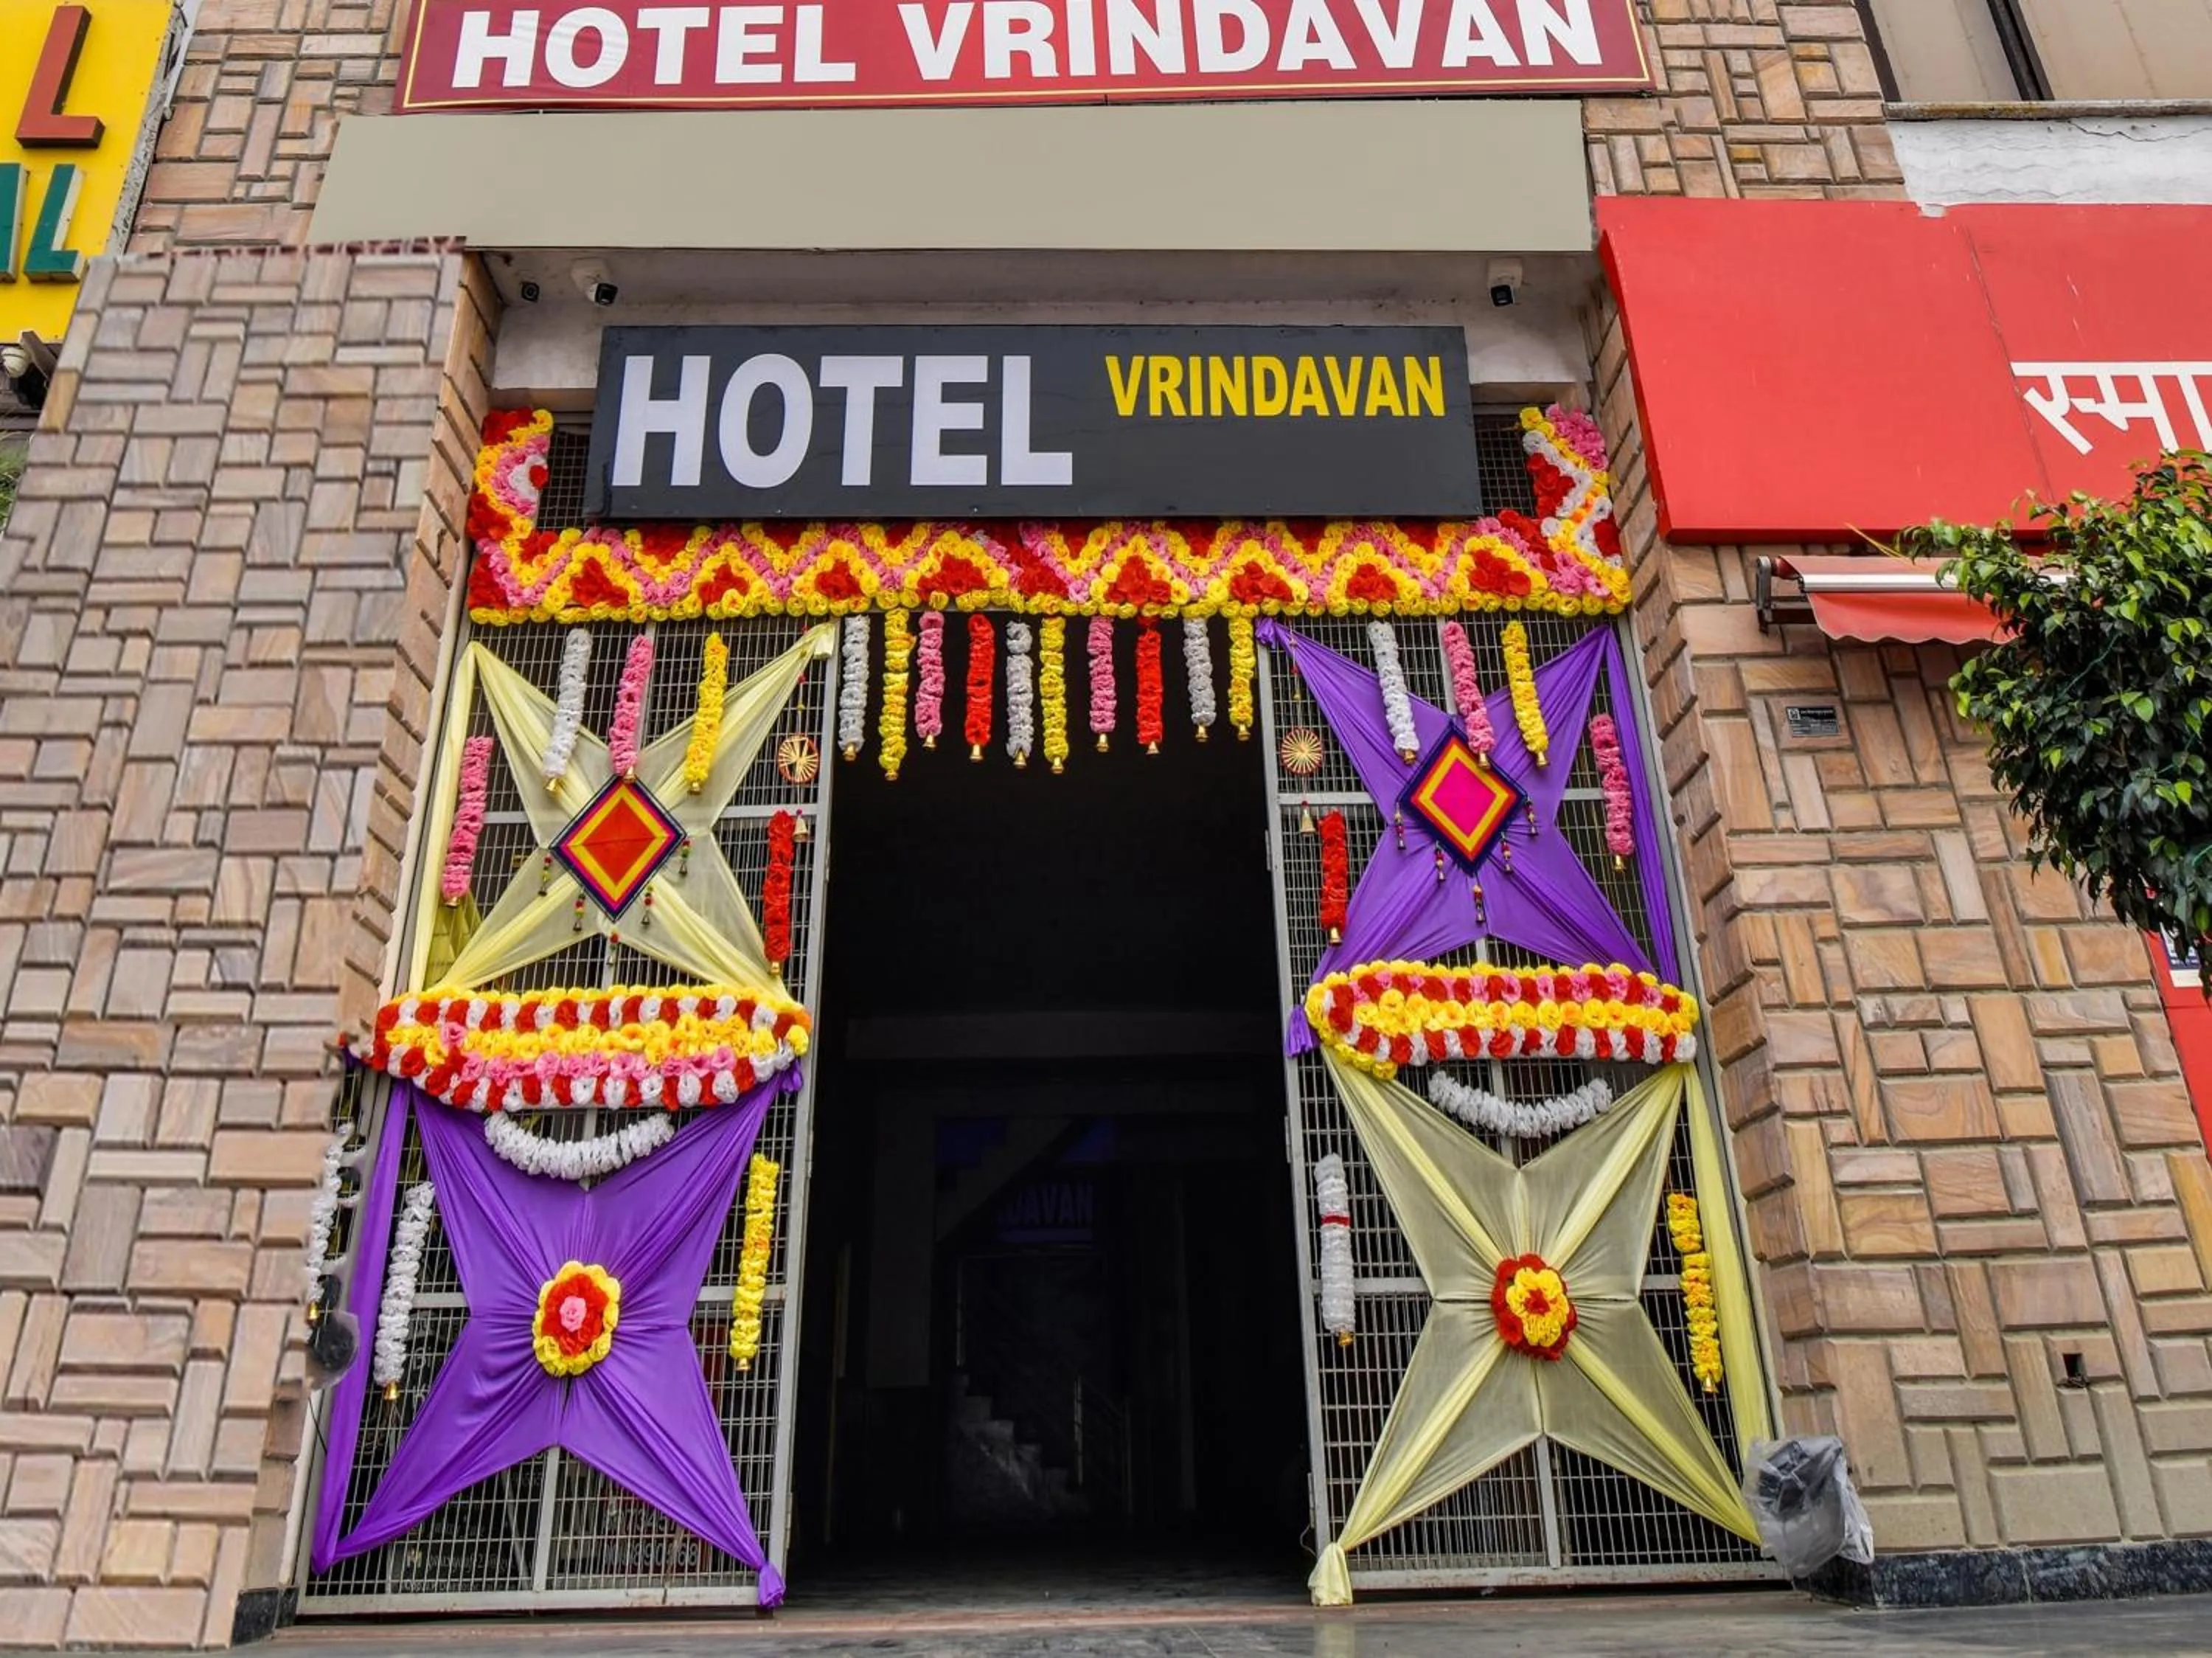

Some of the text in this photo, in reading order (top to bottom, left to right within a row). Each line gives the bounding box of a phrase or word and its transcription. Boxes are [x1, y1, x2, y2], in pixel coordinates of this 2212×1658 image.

[451, 0, 1603, 88] HOTEL VRINDAVAN
[611, 354, 1445, 488] HOTEL VRINDAVAN
